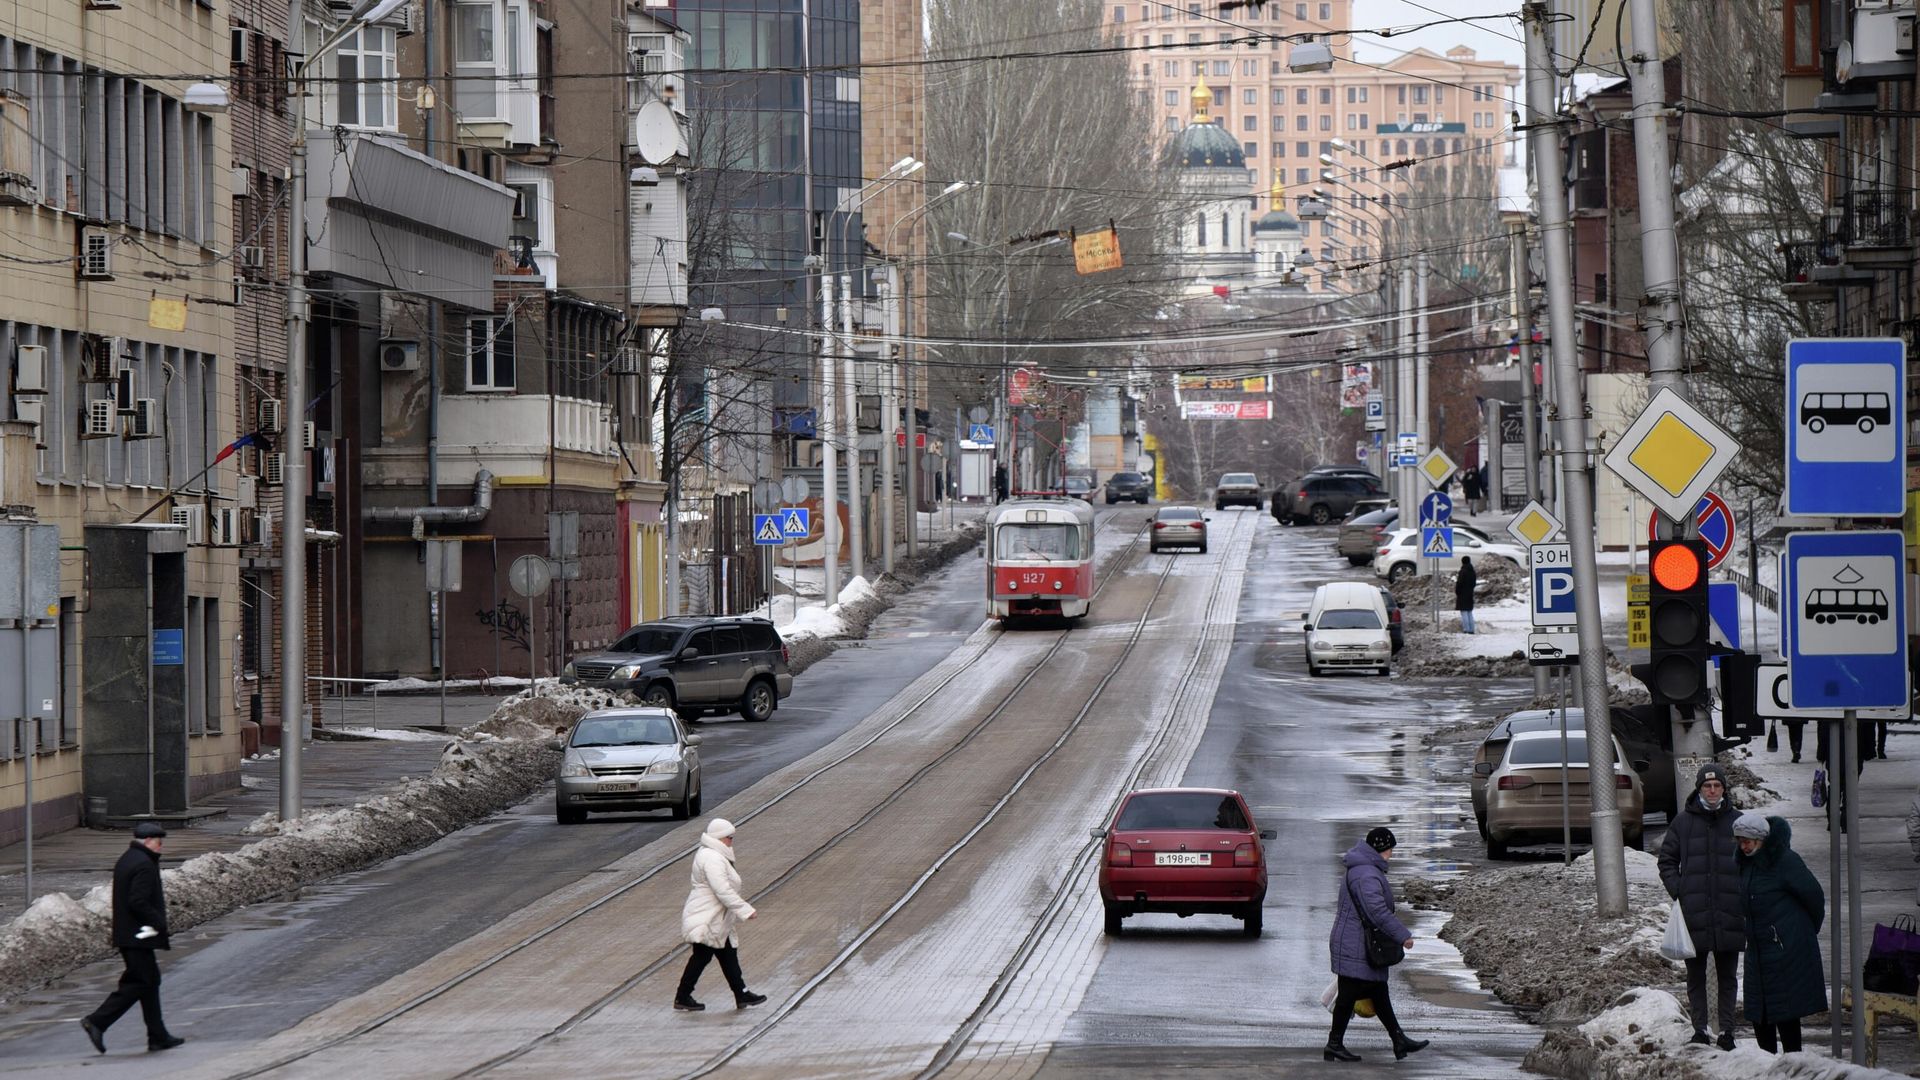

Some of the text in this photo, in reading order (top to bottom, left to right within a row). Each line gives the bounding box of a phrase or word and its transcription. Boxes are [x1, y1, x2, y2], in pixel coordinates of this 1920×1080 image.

[1412, 123, 1444, 132] ВБР
[1214, 403, 1235, 413] 500
[1369, 403, 1380, 415] P
[1034, 512, 1039, 522] 1
[1023, 573, 1045, 584] 927
[1542, 572, 1574, 609] P
